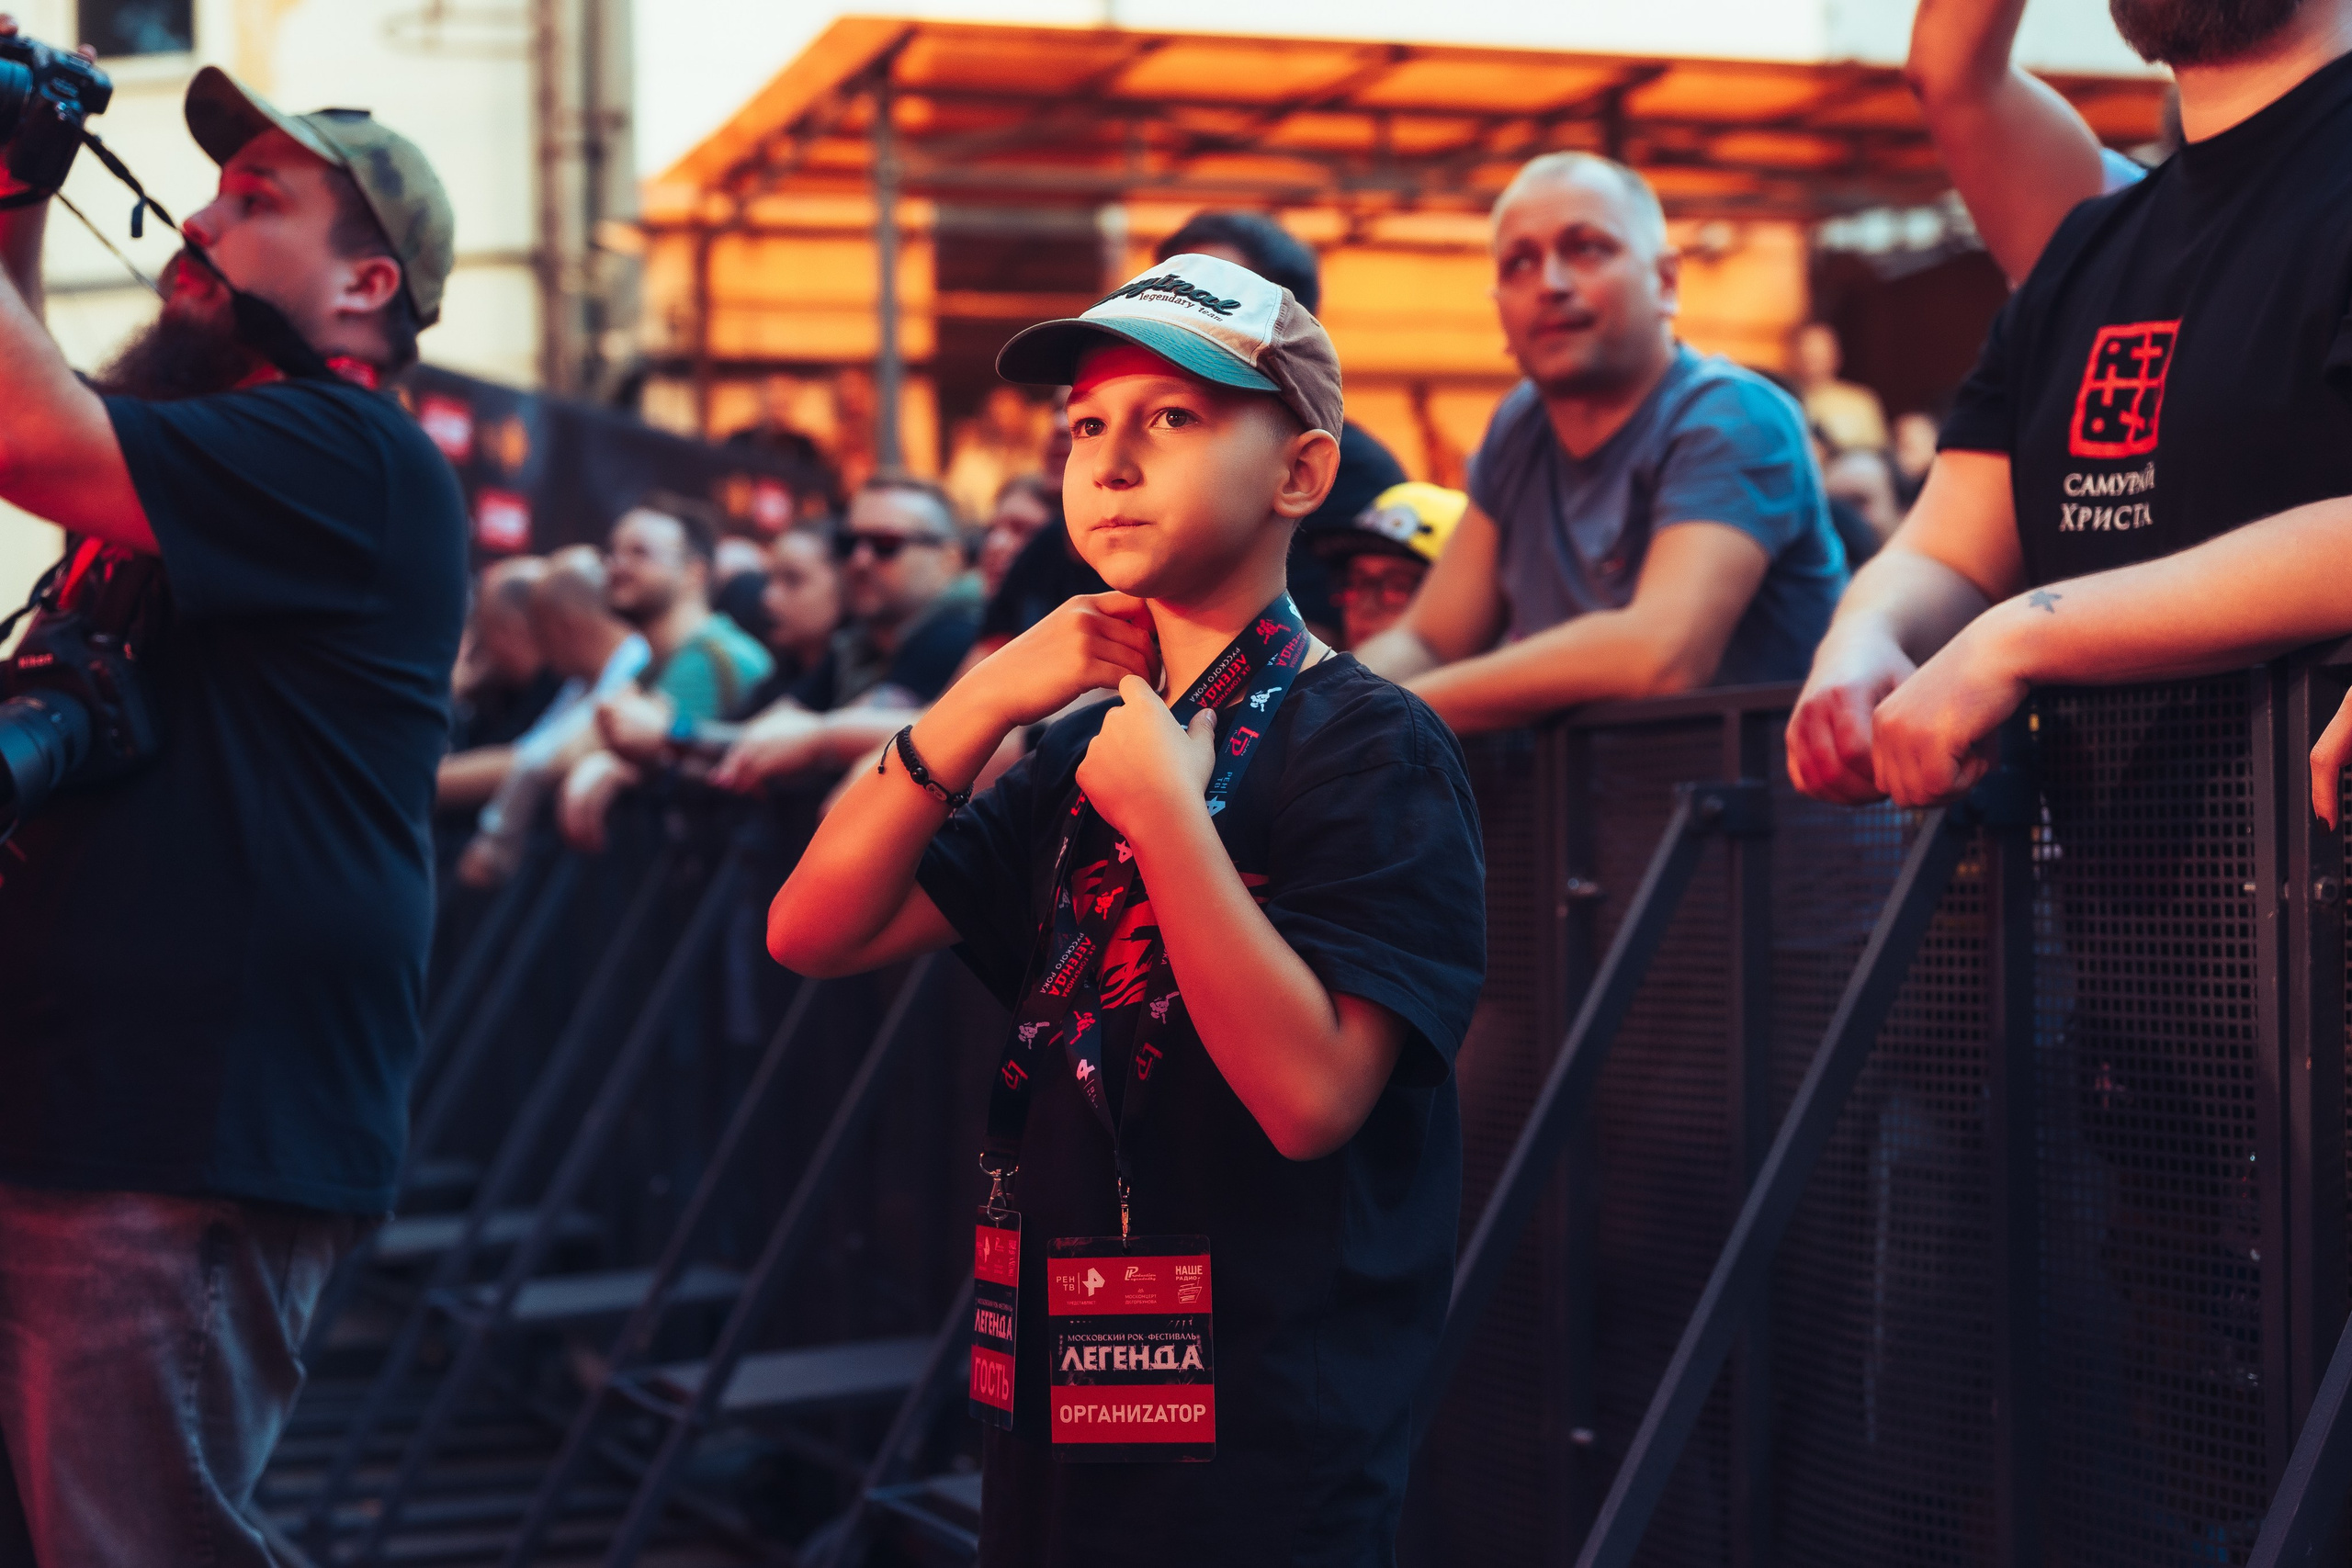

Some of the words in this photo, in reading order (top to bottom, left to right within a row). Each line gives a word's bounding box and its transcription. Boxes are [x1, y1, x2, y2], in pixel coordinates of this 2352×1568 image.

[1138, 292, 1195, 309] legendary
[2063, 461, 2155, 497] САМУРАЙ
[2059, 502, 2154, 532] ХРИСТА
[1207, 647, 1240, 682] РУССКОГО
[1189, 682, 1207, 702] РОКА
[1197, 654, 1247, 708] ЛЕГЕНДА
[1056, 932, 1084, 969] РУССКОГО
[1047, 937, 1091, 996] ЛЕГЕНДА
[1061, 957, 1089, 998] ГОРБУНОВА
[1040, 971, 1057, 993] РОКА
[1175, 1265, 1203, 1275] НАШЕ
[1063, 1283, 1075, 1292] ТВ
[974, 1308, 1012, 1341] ЛЕГЕНДА
[1068, 1333, 1125, 1342] МОСКОВСКИЙ
[1127, 1333, 1197, 1341] РОК-ФЕСТИВАЛЬ
[1059, 1344, 1204, 1372] ЛЕГЕНДА
[974, 1357, 1009, 1401] ГОСТЬ
[1059, 1404, 1206, 1424] ОРГАНИZАТОР
